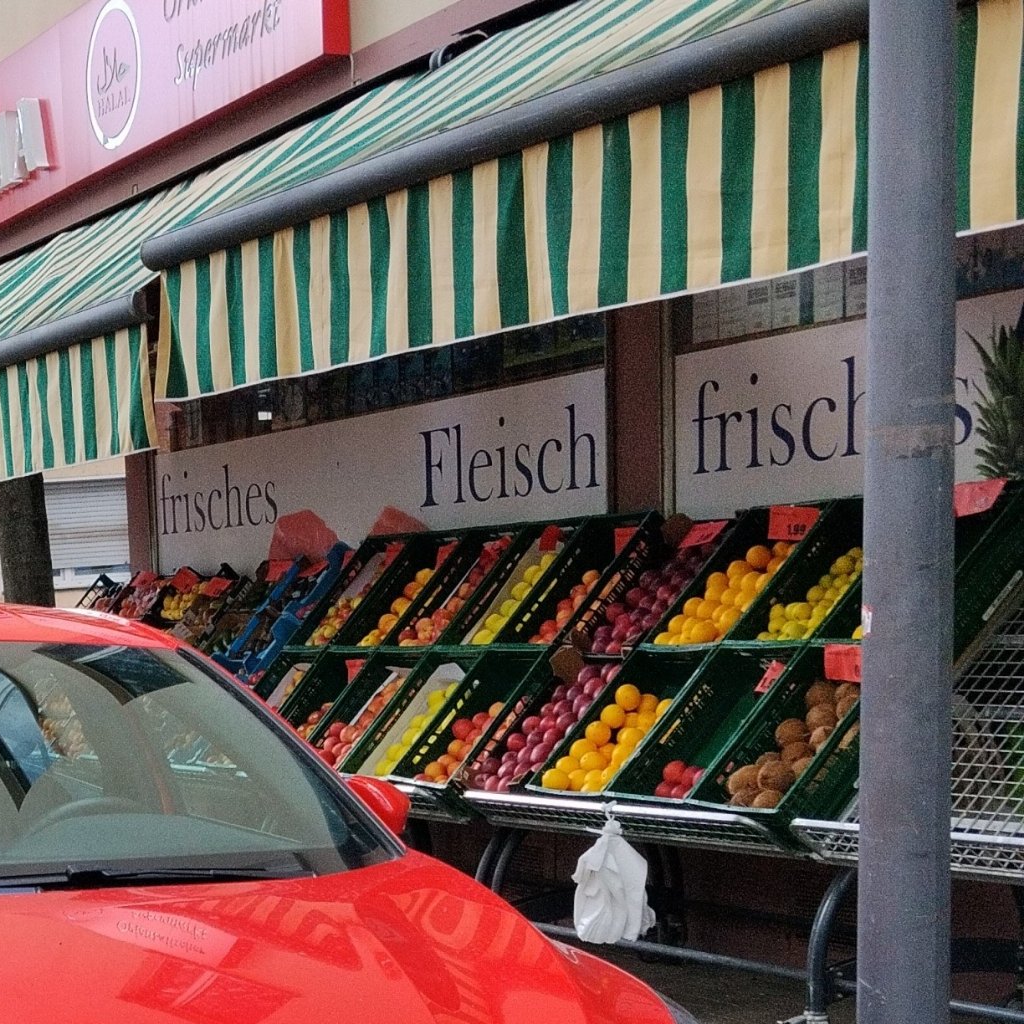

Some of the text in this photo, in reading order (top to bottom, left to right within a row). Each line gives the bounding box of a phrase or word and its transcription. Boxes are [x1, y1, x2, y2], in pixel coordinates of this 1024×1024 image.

[174, 0, 280, 91] Supermarkt
[160, 404, 600, 535] frisches Fleisch
